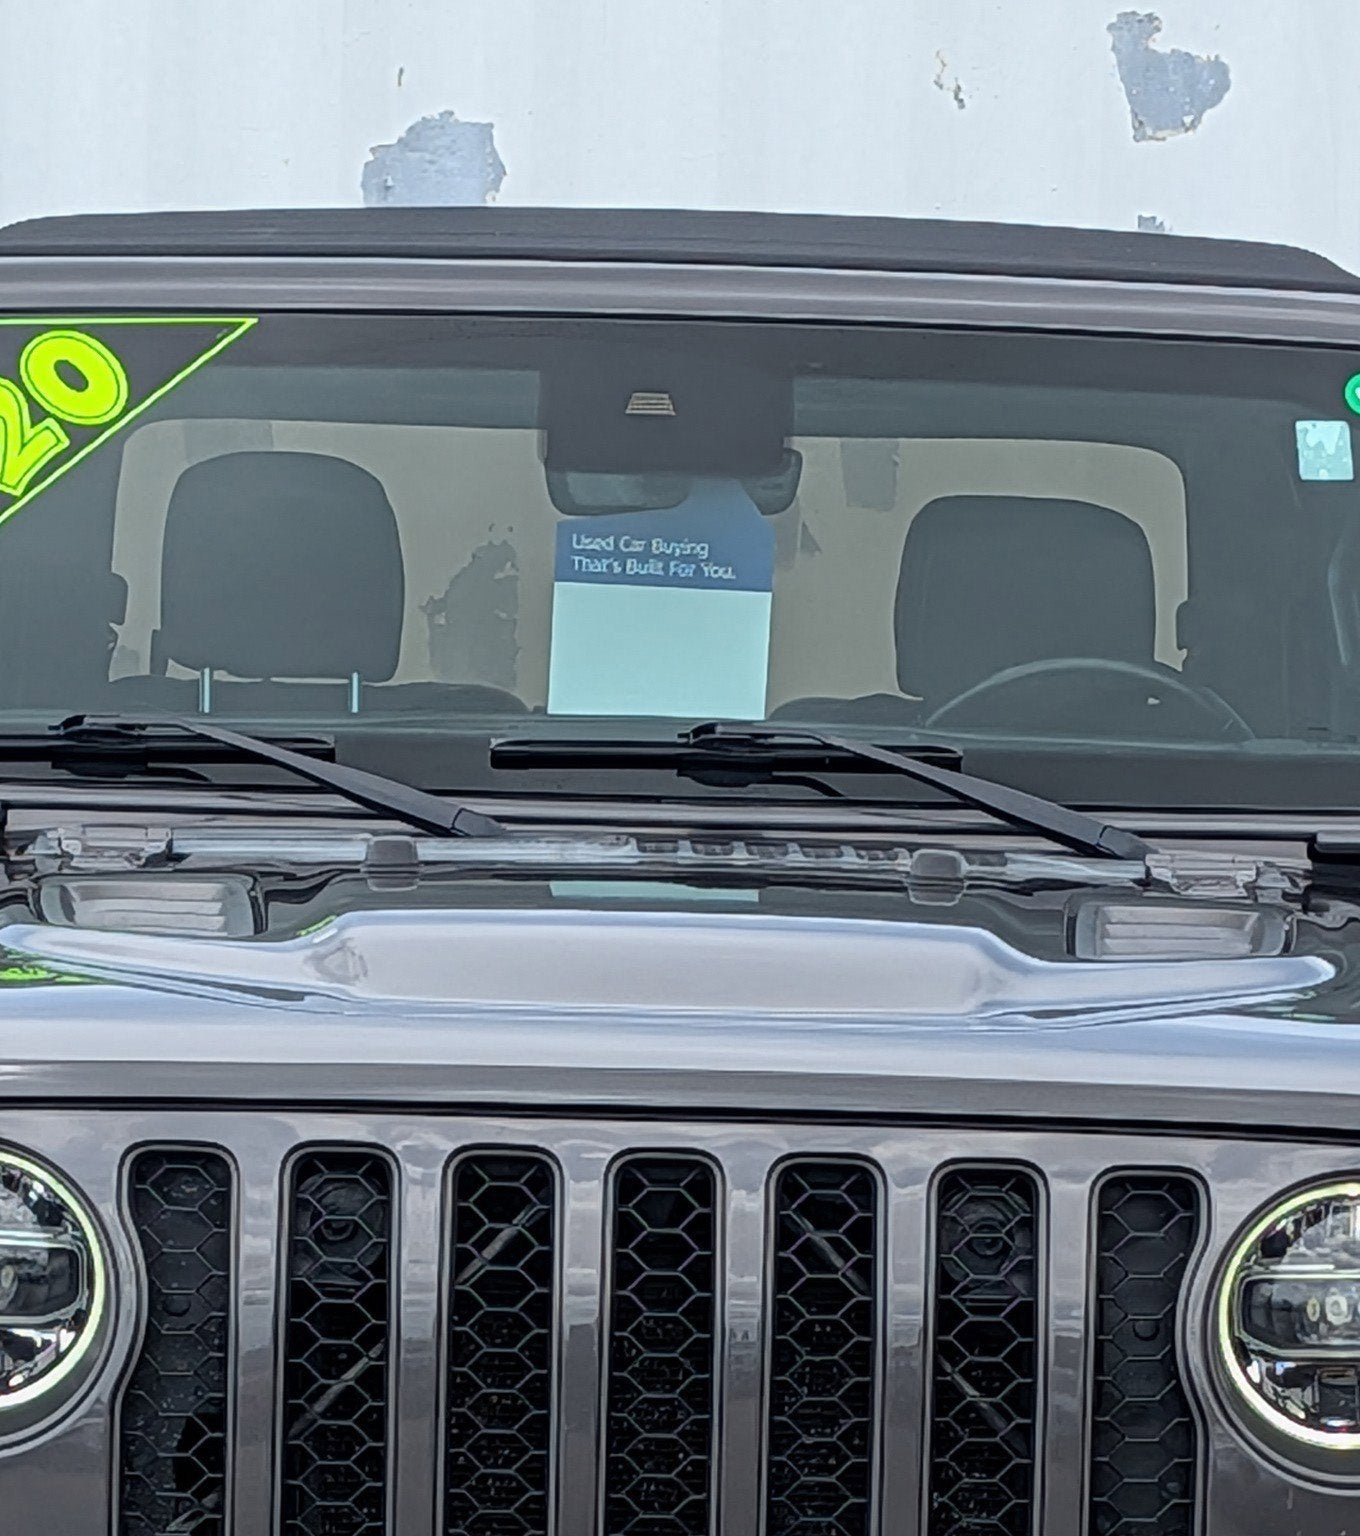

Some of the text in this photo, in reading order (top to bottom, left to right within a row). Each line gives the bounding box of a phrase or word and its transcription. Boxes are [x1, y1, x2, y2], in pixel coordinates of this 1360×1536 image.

[571, 533, 710, 560] Used Car Buying
[570, 555, 737, 580] That's Built For You.
